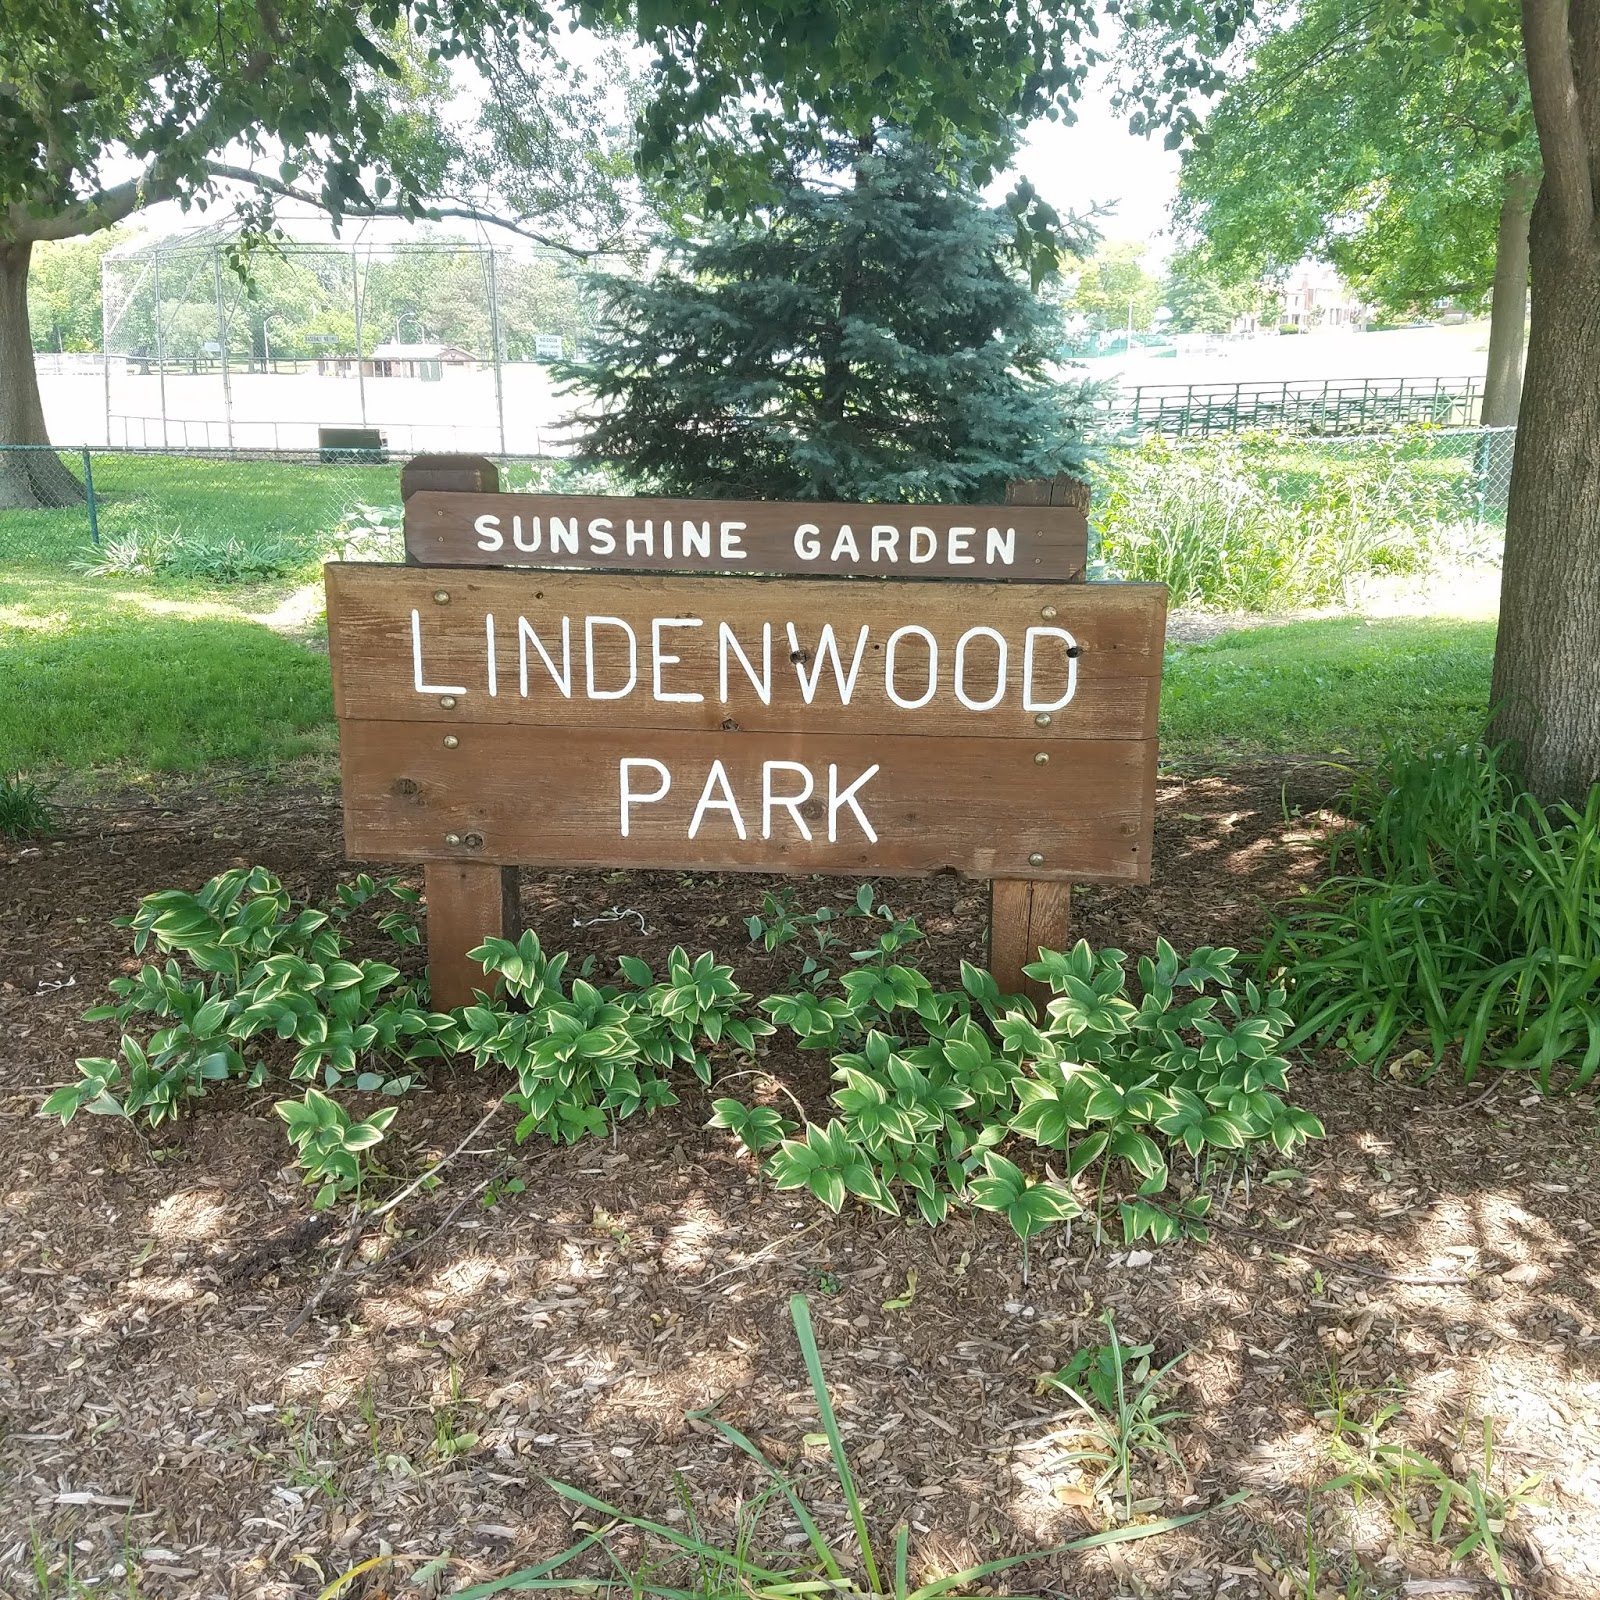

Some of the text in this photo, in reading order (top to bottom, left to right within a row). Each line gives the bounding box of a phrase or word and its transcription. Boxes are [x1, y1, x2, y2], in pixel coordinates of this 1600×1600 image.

[474, 514, 1017, 565] SUNSHINE GARDEN
[412, 608, 1079, 713] LINDENWOOD
[619, 757, 880, 844] PARK
